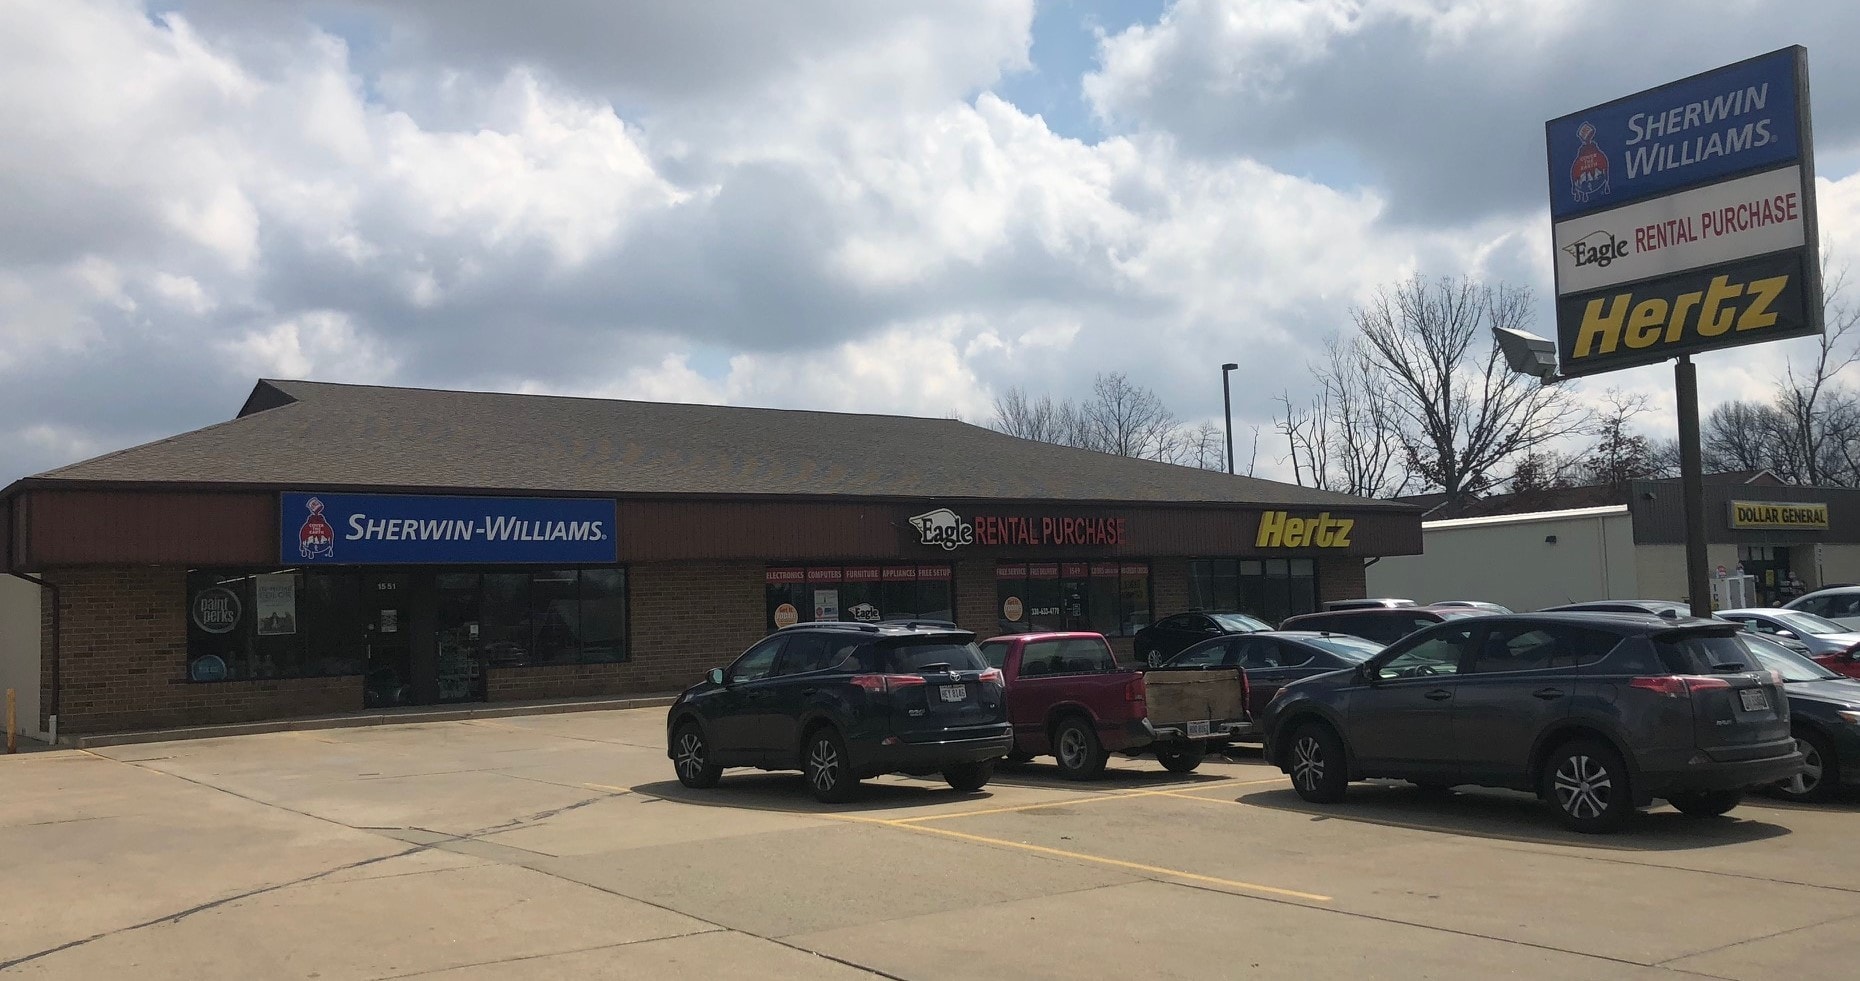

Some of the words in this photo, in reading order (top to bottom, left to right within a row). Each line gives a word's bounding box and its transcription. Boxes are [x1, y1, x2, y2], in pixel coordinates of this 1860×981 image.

[1625, 82, 1769, 146] SHERWIN
[1624, 118, 1772, 180] WILLIAMS
[1574, 234, 1629, 267] Eagle
[1635, 216, 1698, 254] RENTAL
[1702, 192, 1798, 240] PURCHASE
[1572, 274, 1790, 360] Hertz
[1737, 506, 1779, 523] DOLLAR
[1781, 508, 1826, 524] GENERAL
[345, 513, 602, 541] SHERWIN-WILLIAMS
[922, 517, 972, 549] Eagle
[974, 516, 1039, 545] RENTAL
[1042, 517, 1127, 545] PURCHASE
[1254, 510, 1355, 548] Hertz
[766, 572, 804, 580] ELECTRONICS
[807, 570, 842, 579] COMPUTERS
[846, 570, 879, 578] FURNITURE
[882, 569, 916, 577] APPLIANCES
[918, 569, 933, 577] FREE
[377, 582, 397, 590] 1551
[200, 596, 229, 612] paint
[854, 606, 879, 618] Eagle
[203, 609, 234, 625] perks
